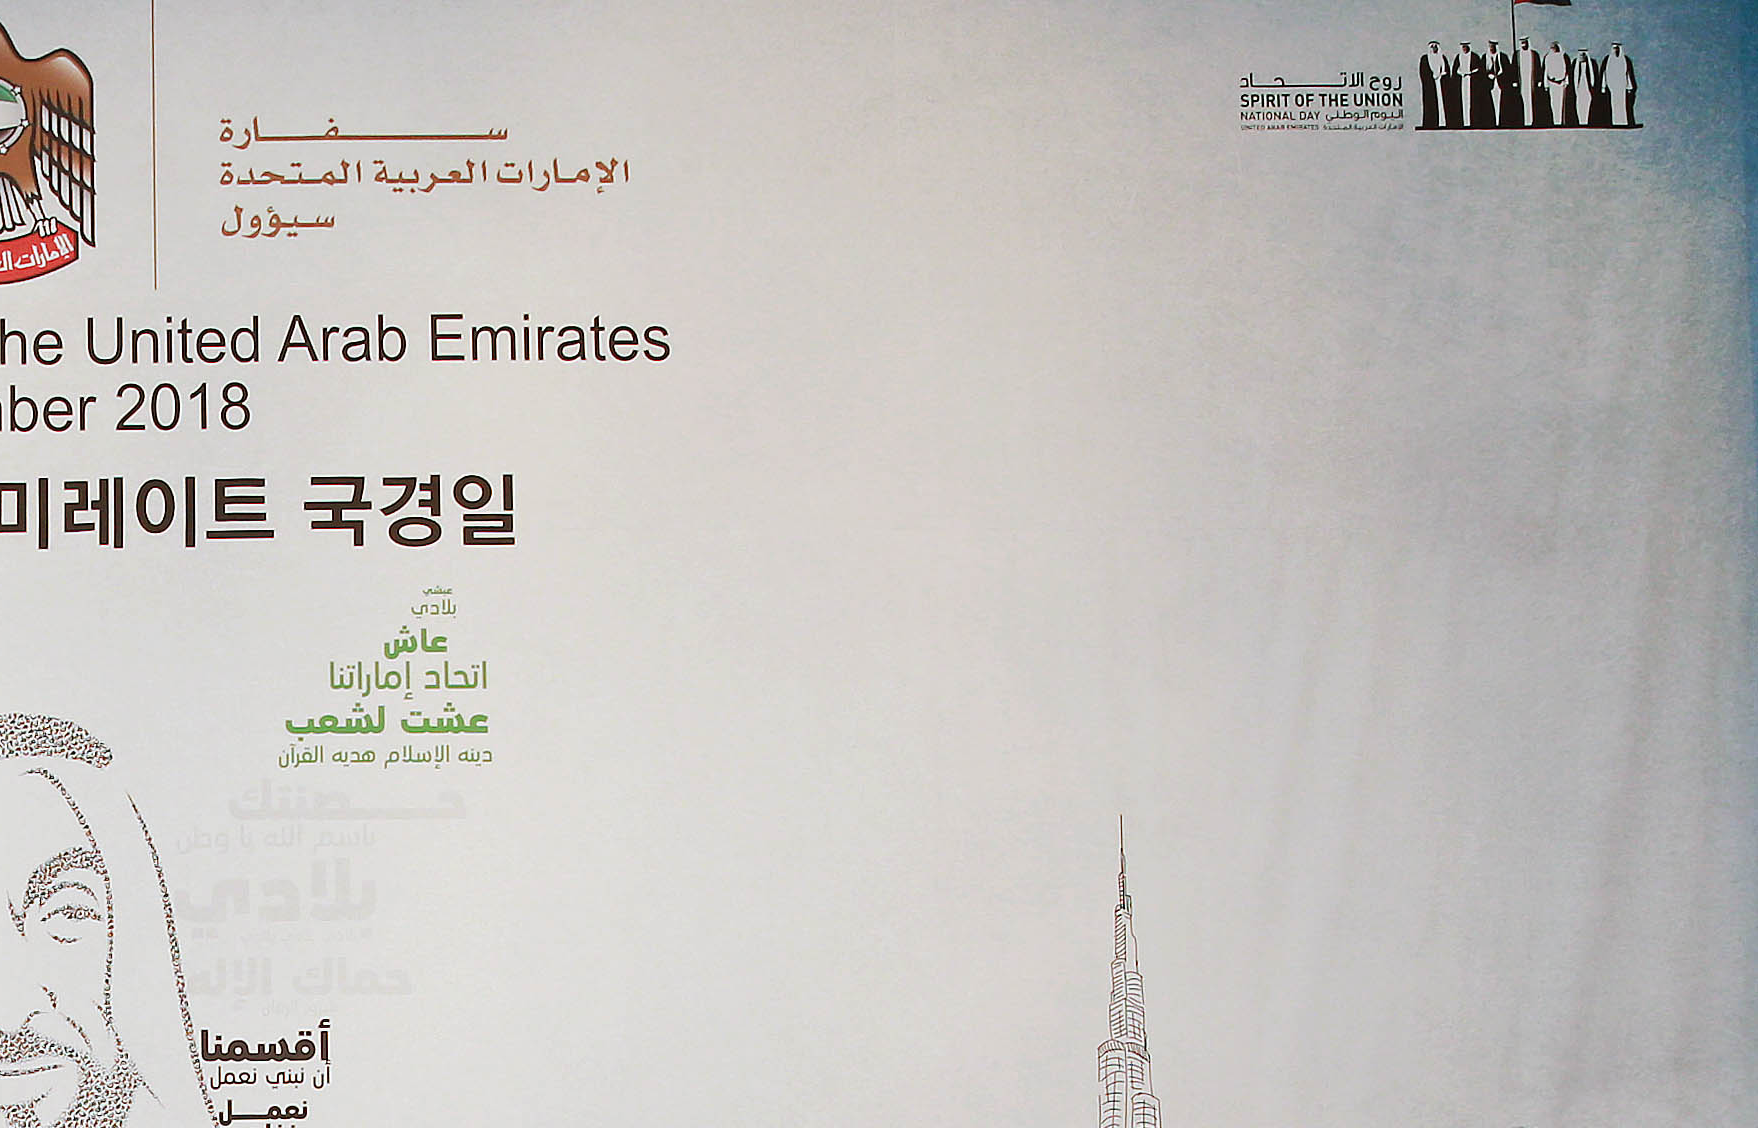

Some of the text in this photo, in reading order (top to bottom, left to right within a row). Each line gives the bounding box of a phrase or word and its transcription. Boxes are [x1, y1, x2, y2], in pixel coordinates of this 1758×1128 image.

[1241, 93, 1402, 107] SPIRIT OF THE UNION
[1370, 76, 1401, 91] روح
[1241, 111, 1320, 120] NATIONAL DAY
[220, 116, 507, 149] سفارة
[220, 158, 628, 193] الإمارات العربية المتحدة
[222, 205, 334, 238] سيؤول
[88, 316, 259, 365] United
[278, 314, 406, 362] Arab
[431, 314, 670, 361] Emirates
[116, 382, 250, 430] 2018
[304, 474, 515, 547] 국경일
[411, 599, 456, 618] بلادي
[384, 626, 447, 659] عاش
[330, 661, 486, 700] اتحاد إماراتنا
[286, 702, 488, 741] عشت لشعب
[385, 744, 449, 769] الإسلام
[458, 749, 492, 766] دينه
[201, 1018, 331, 1062] أقسمنا
[210, 1060, 330, 1090] أن نبني نعمل
[219, 1099, 308, 1126] نعمل
